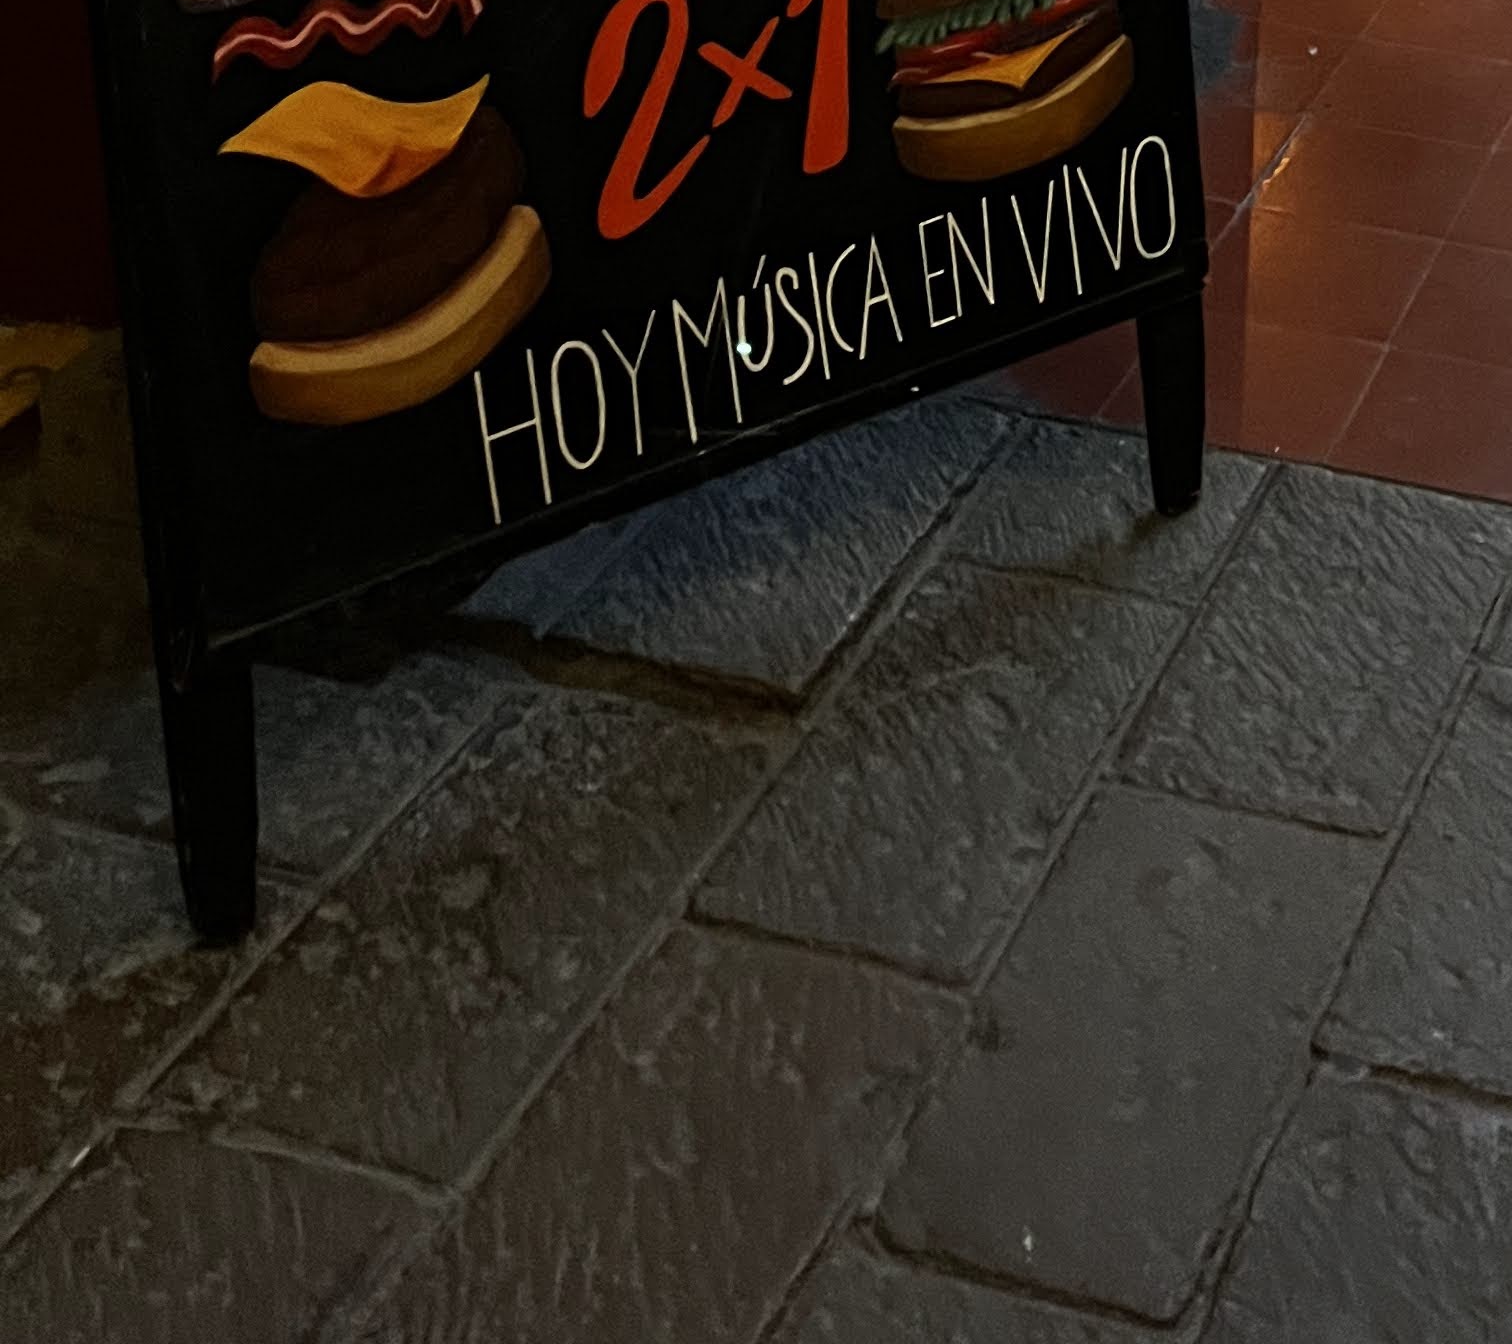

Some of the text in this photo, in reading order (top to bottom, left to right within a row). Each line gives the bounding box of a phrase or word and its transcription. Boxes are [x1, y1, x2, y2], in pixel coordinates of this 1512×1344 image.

[472, 134, 1176, 525] HOY MÚSICA EN VIVO
